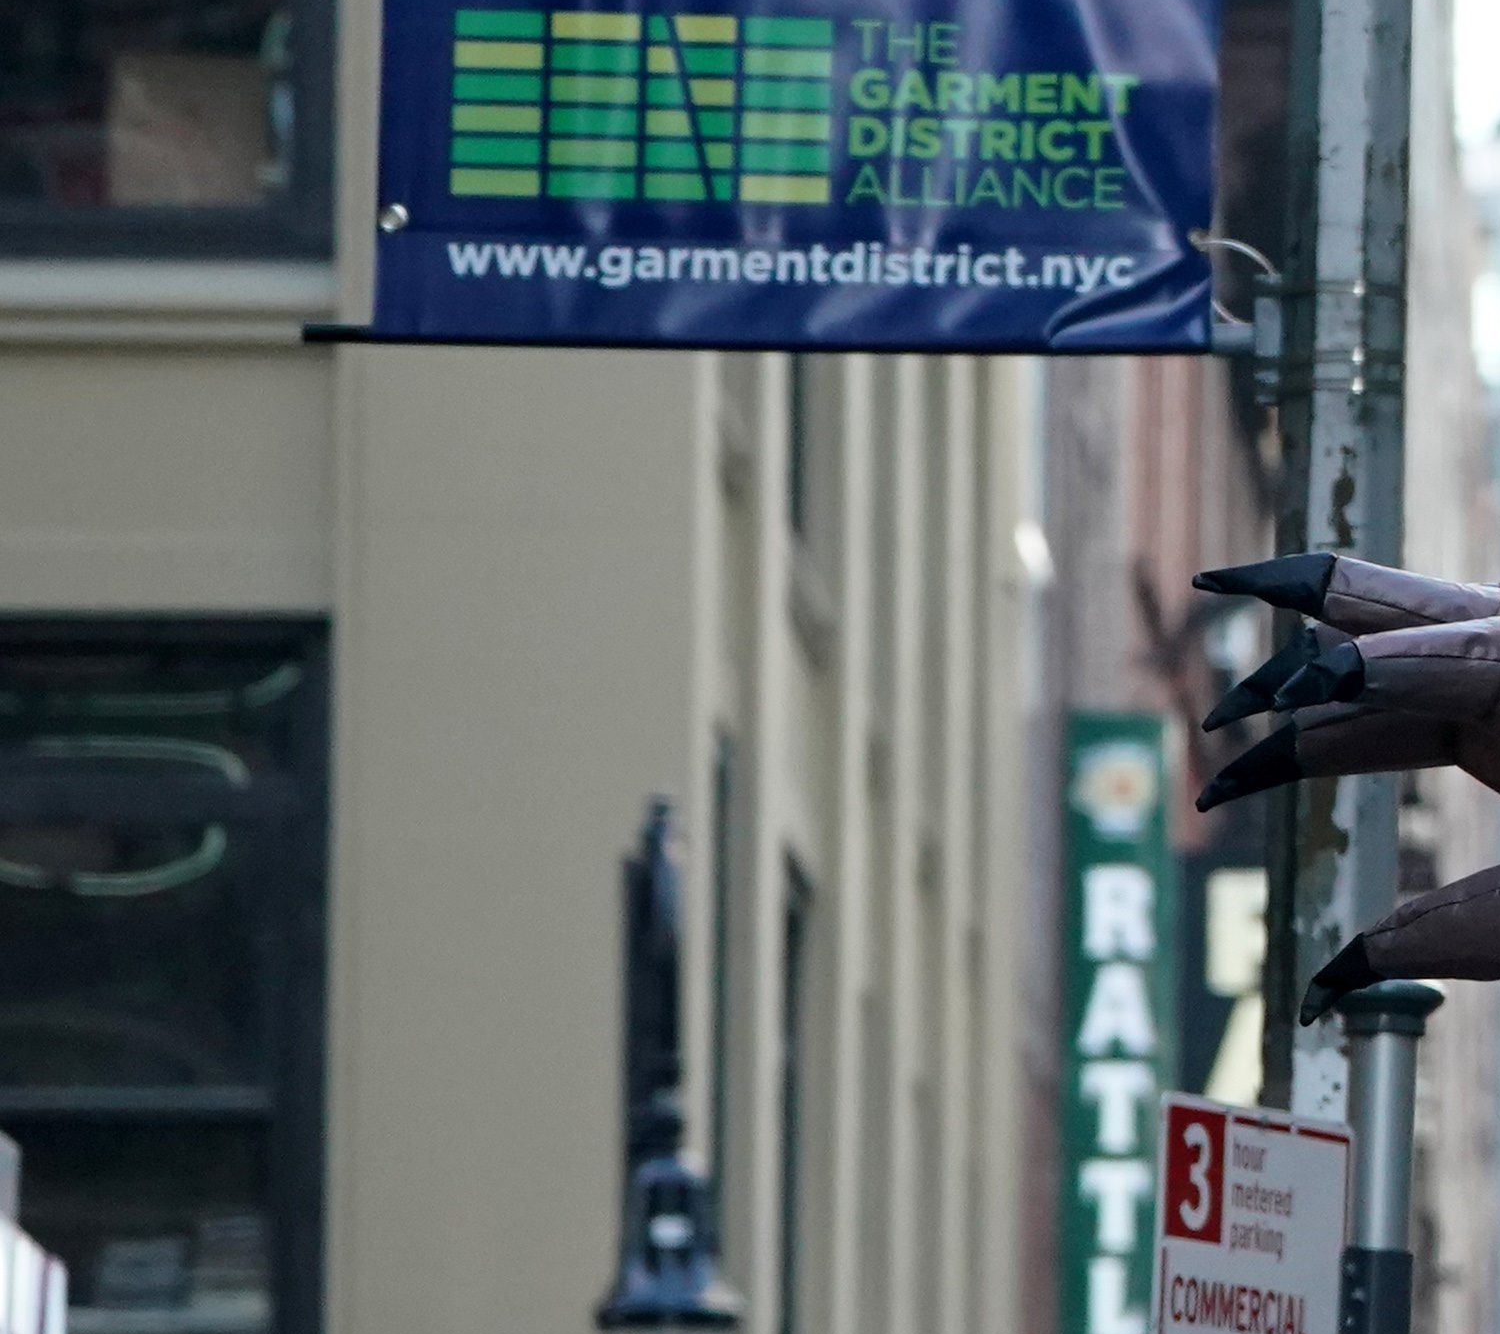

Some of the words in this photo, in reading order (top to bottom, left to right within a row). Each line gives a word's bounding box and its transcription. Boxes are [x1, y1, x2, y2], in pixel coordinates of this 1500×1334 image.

[850, 19, 963, 67] THE
[848, 69, 1140, 115] GARMENT
[847, 117, 1114, 162] DISTRICT
[845, 165, 1127, 211] ALLIANCE
[448, 240, 1136, 293] www.garmentdistrict.nyc
[1179, 1122, 1212, 1231] 3
[1233, 1137, 1267, 1171] hour
[1231, 1180, 1293, 1217] metered
[1229, 1221, 1284, 1262] parking
